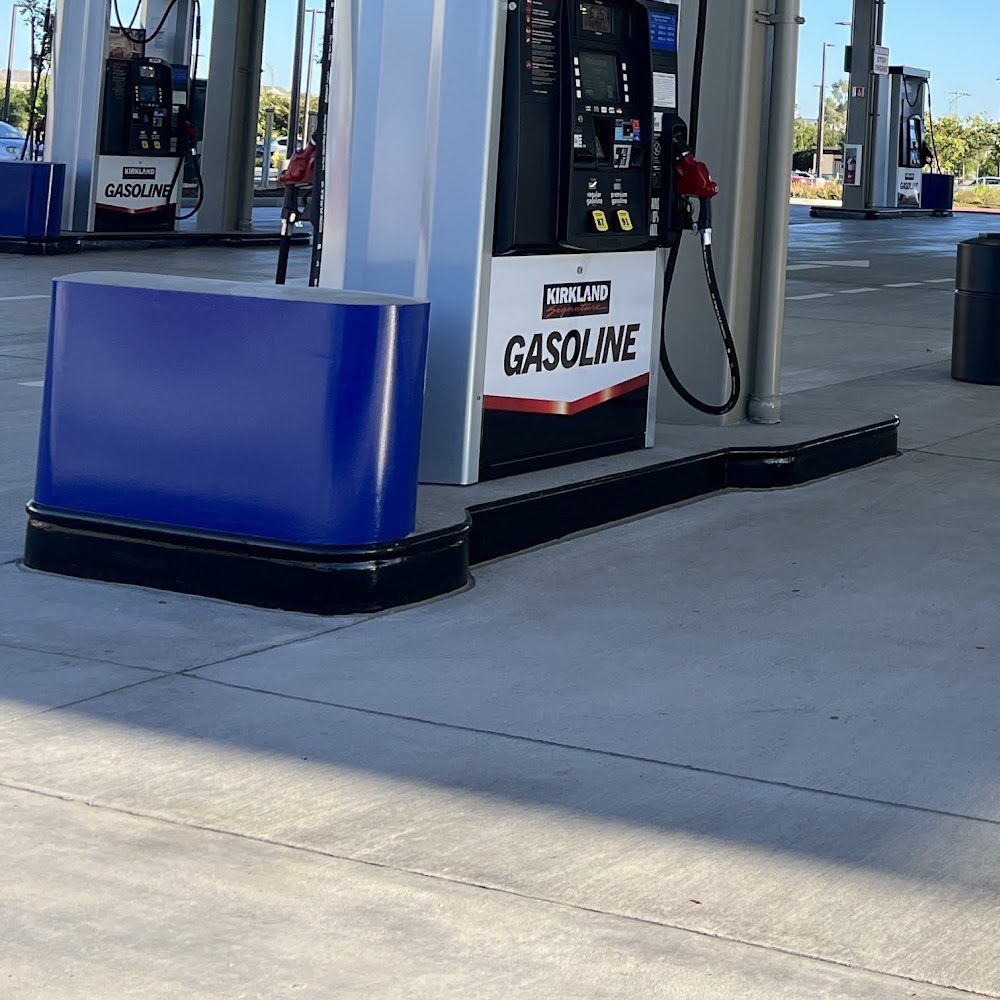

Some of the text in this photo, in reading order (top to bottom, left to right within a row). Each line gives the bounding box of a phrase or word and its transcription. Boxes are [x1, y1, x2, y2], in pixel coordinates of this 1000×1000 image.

[105, 183, 171, 198] GASOLINE
[546, 284, 609, 305] KIRKLAND
[545, 303, 608, 319] Signature
[503, 323, 641, 377] GASOLINE
